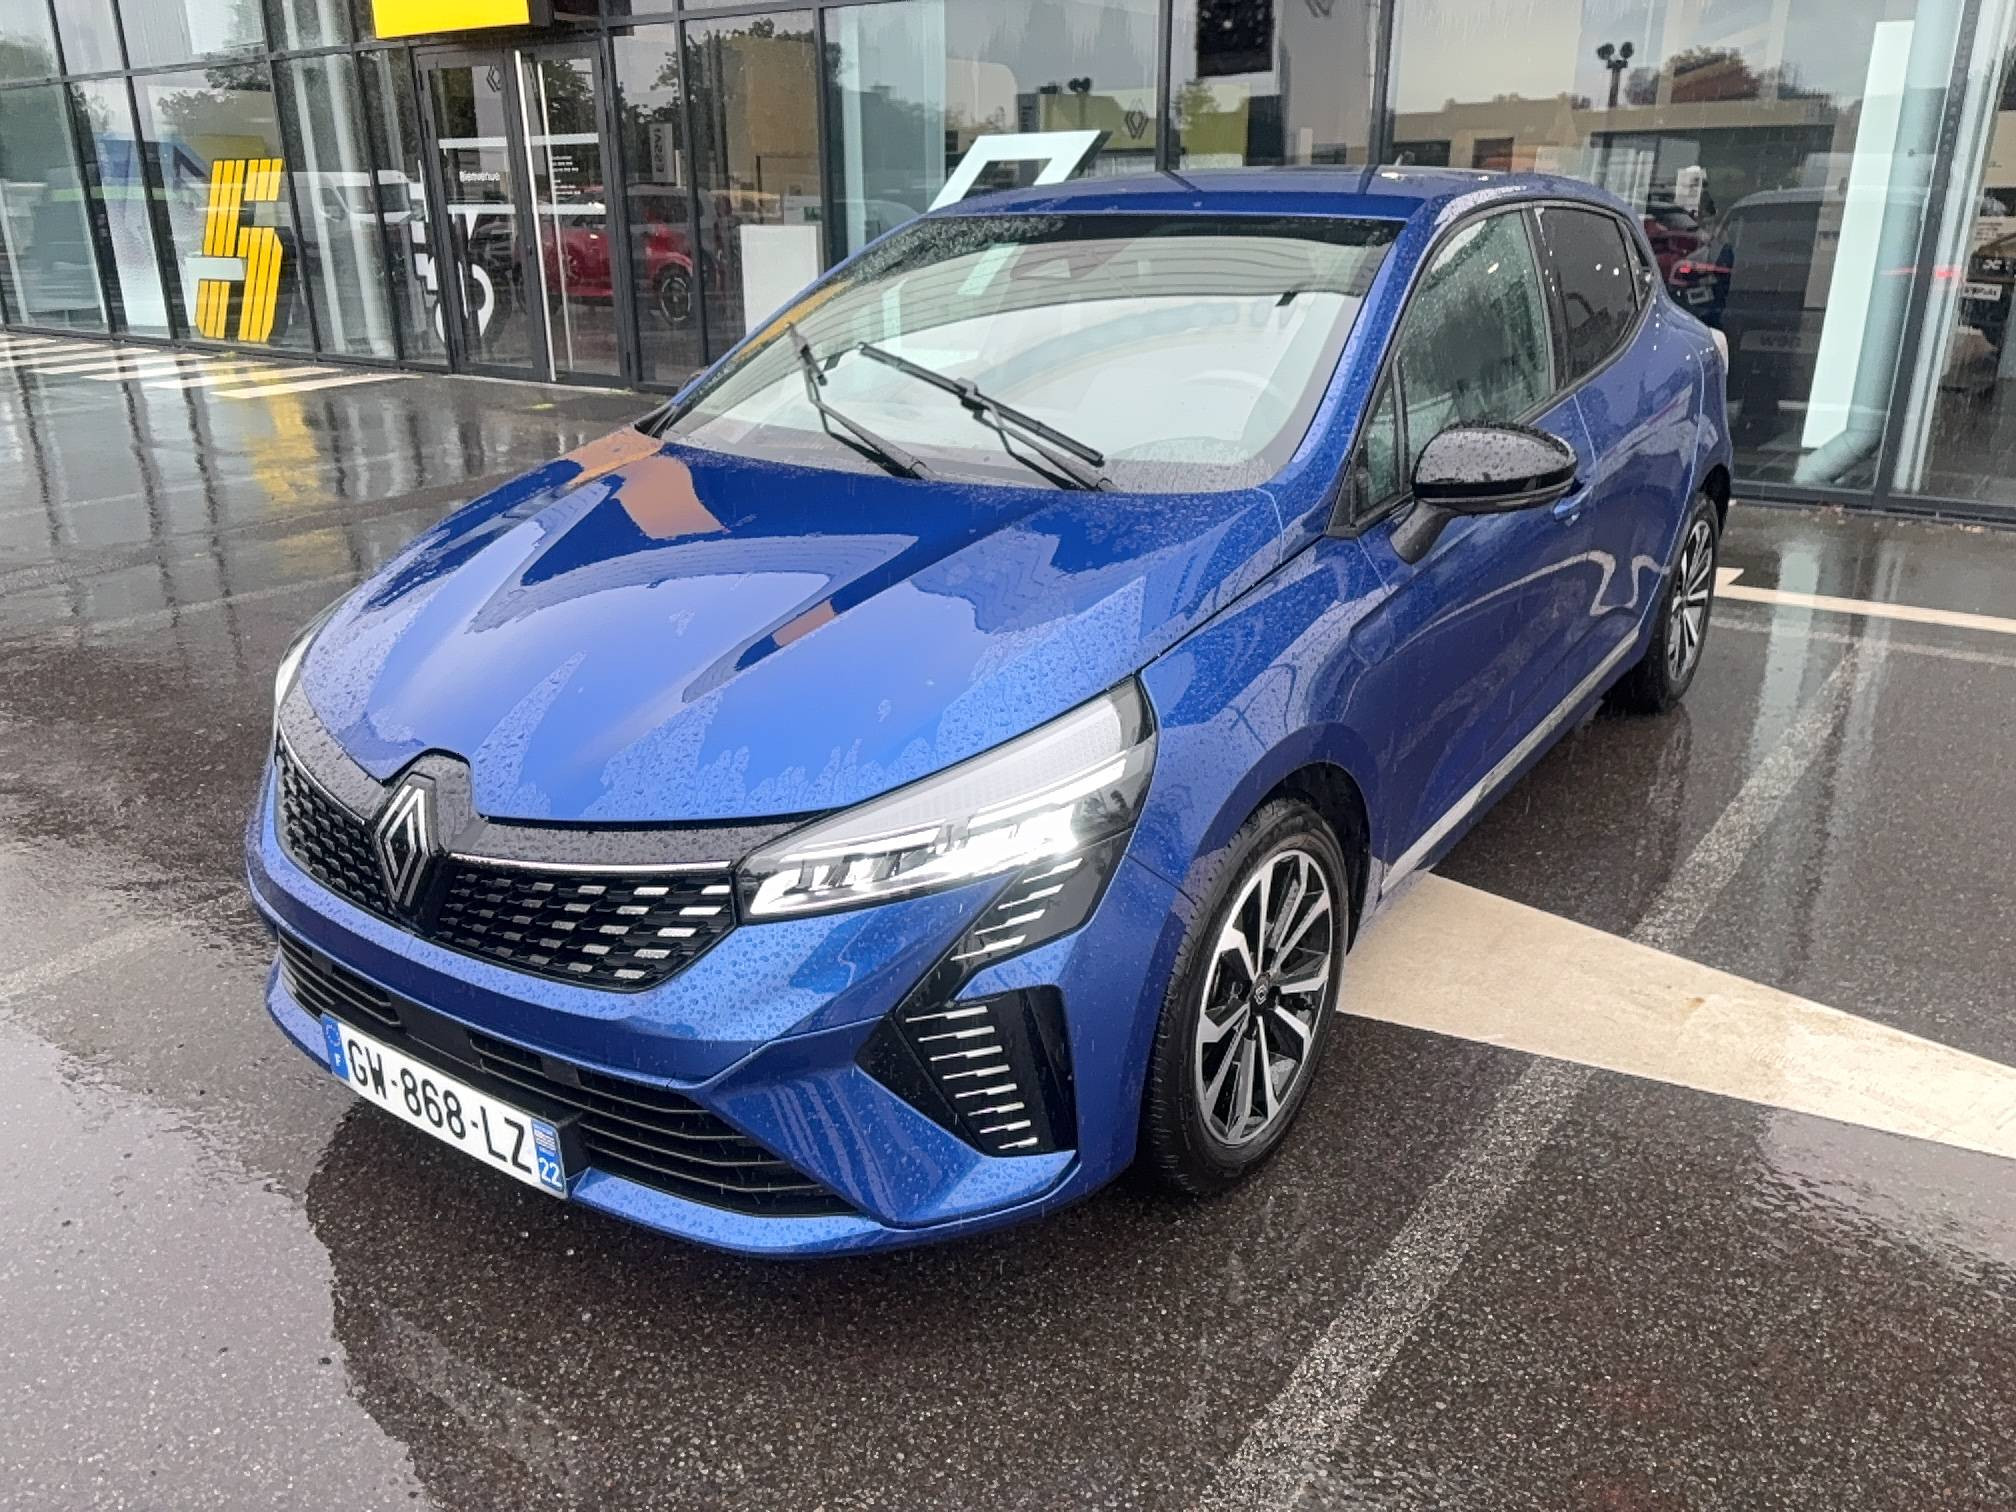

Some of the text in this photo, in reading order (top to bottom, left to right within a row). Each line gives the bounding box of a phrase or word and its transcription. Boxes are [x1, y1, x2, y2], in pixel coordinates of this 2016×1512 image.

[334, 1053, 343, 1067] F
[347, 1039, 532, 1175] GW-868-LZ
[538, 1157, 562, 1187] 22
